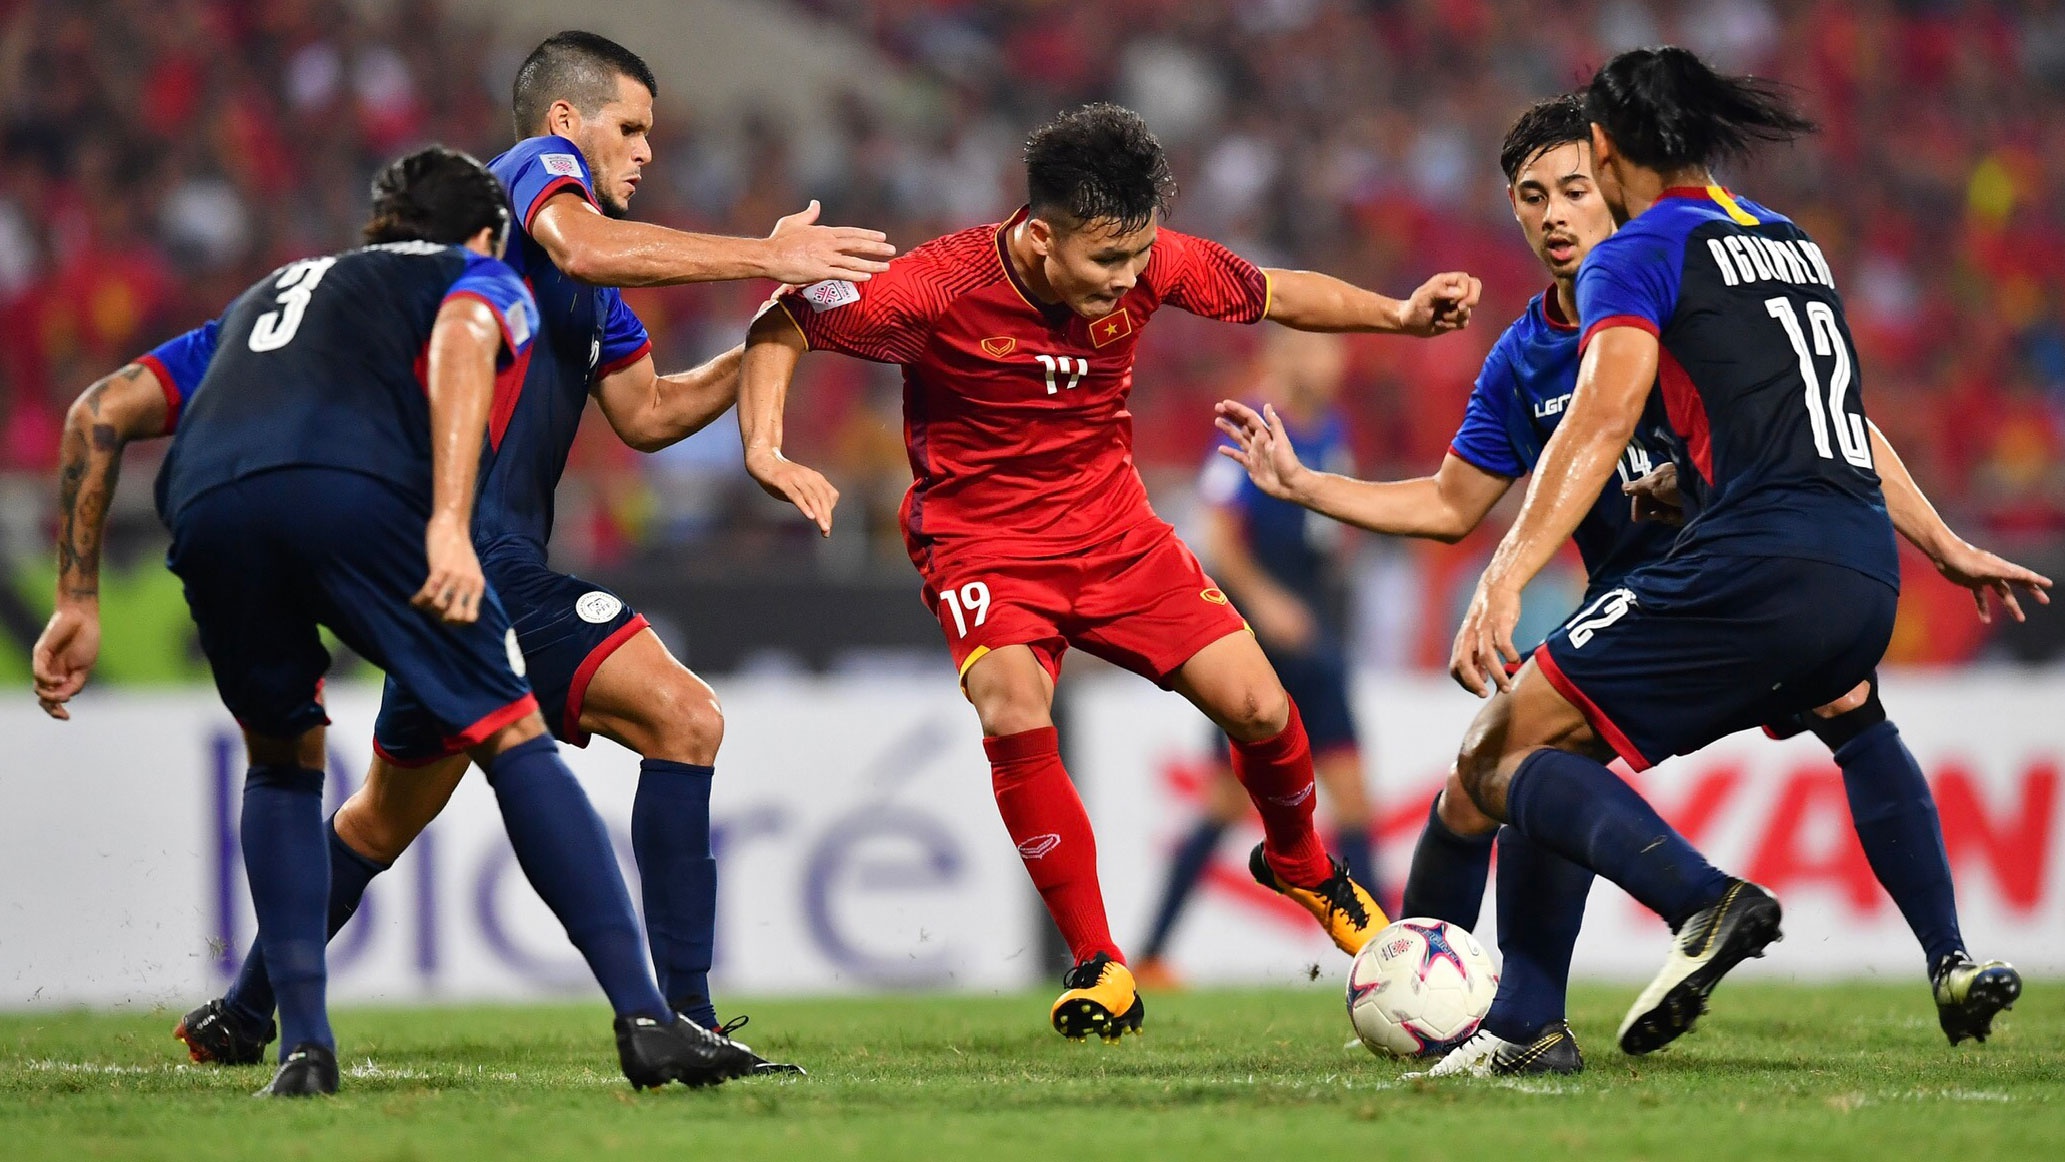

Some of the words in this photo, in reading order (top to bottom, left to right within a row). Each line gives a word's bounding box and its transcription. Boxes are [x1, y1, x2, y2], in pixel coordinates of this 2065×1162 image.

[248, 256, 337, 352] 3
[1764, 296, 1873, 470] 12
[939, 581, 991, 639] 19
[1565, 588, 1638, 650] 12
